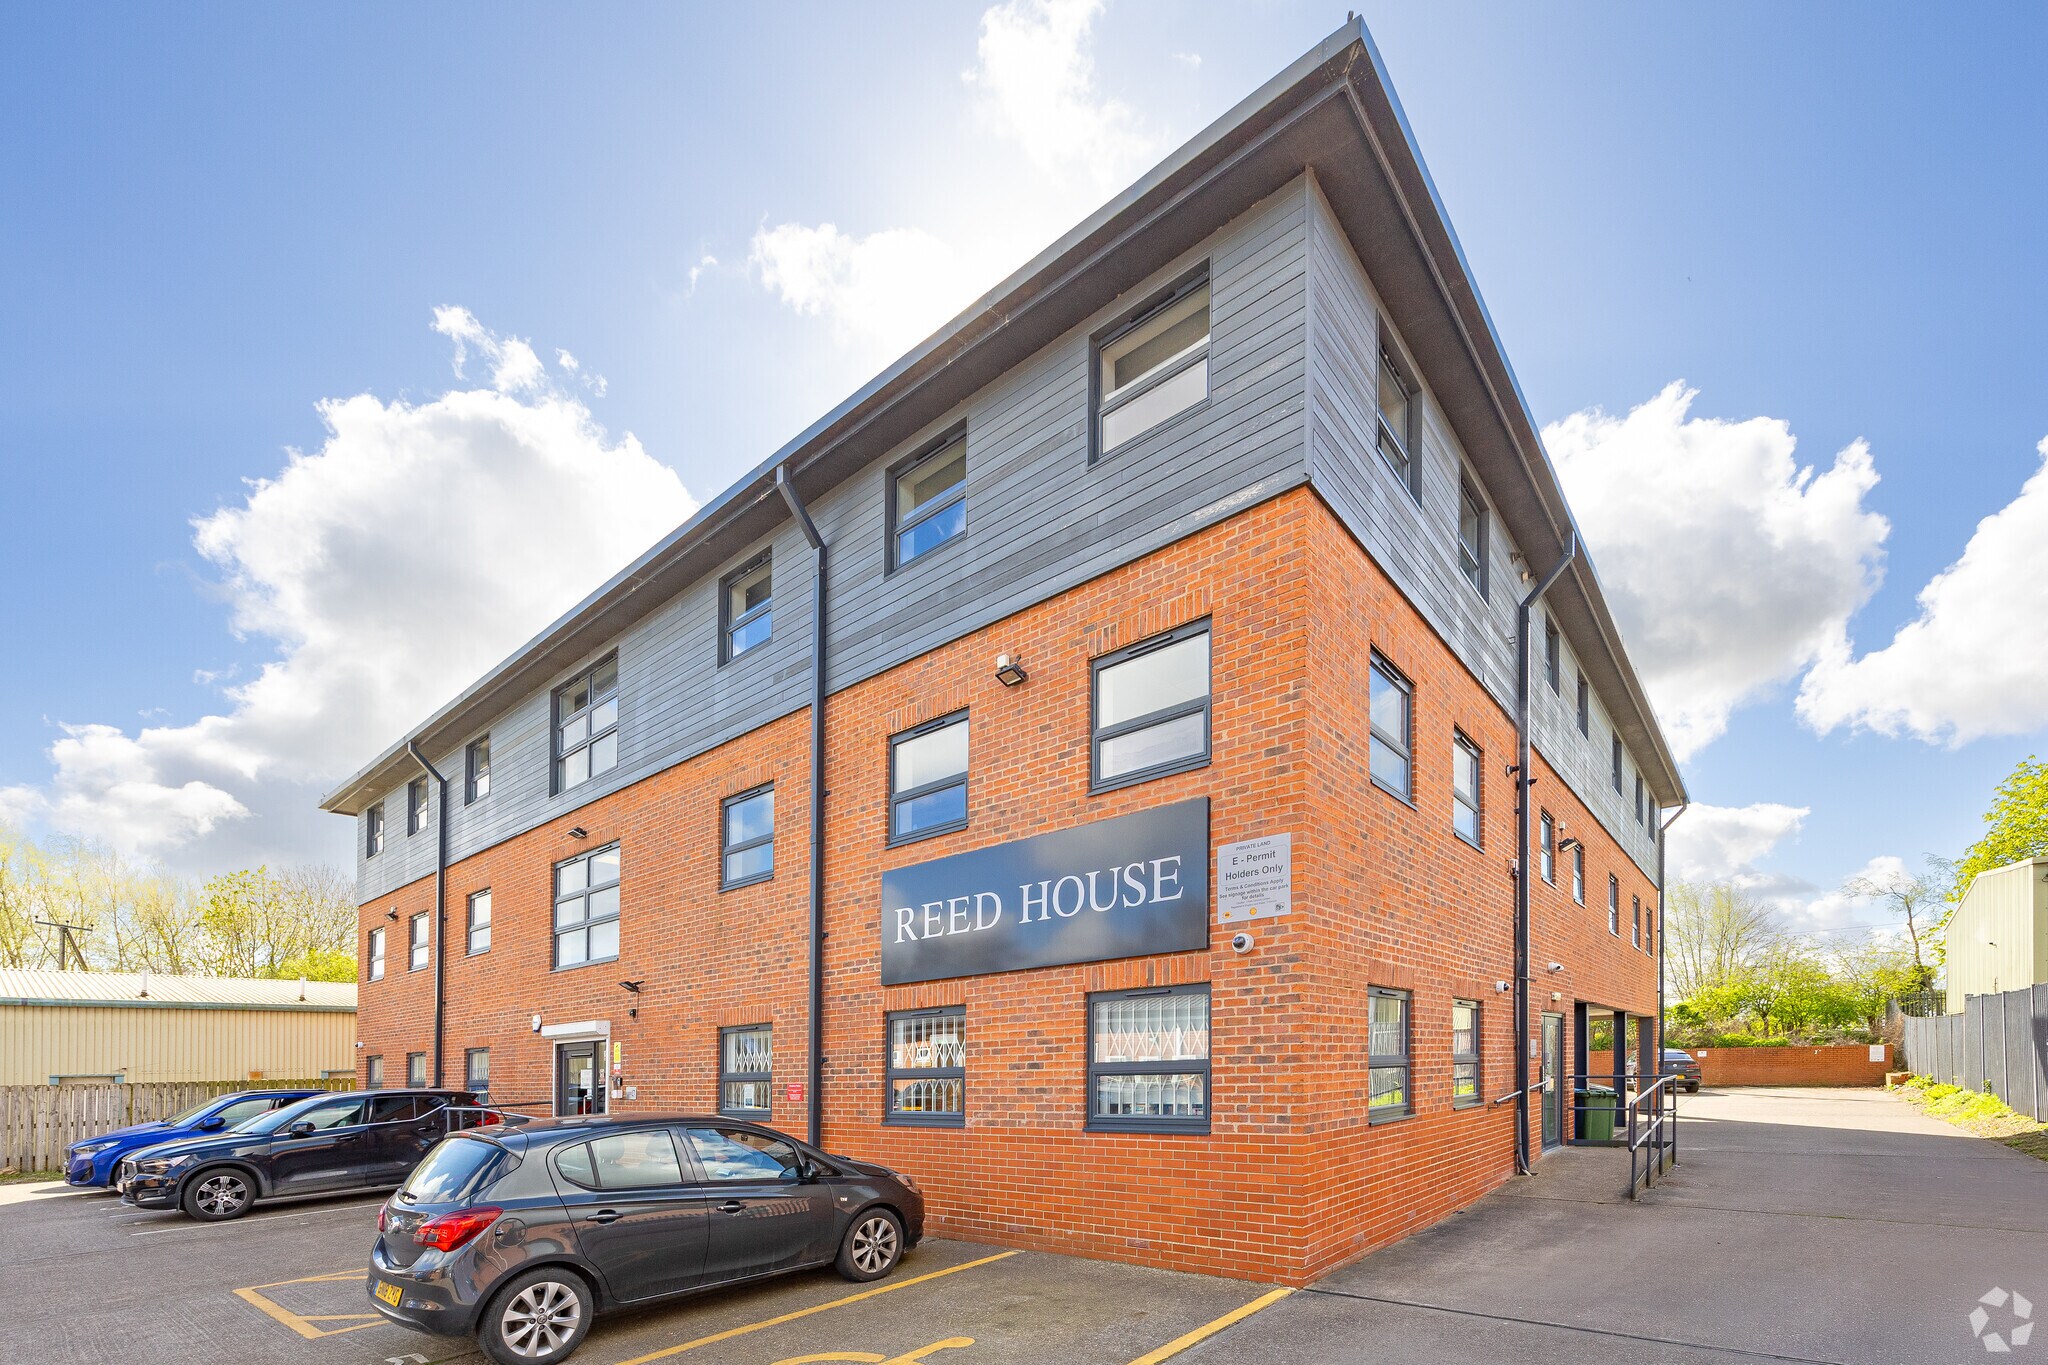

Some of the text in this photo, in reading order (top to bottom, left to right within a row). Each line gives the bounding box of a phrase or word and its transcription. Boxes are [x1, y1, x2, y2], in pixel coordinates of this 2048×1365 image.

[1236, 843, 1256, 851] PRIVATE
[1232, 857, 1238, 865] E
[1246, 850, 1276, 862] Permit
[1225, 864, 1283, 880] Holders Only
[894, 855, 1183, 944] REED HOUSE
